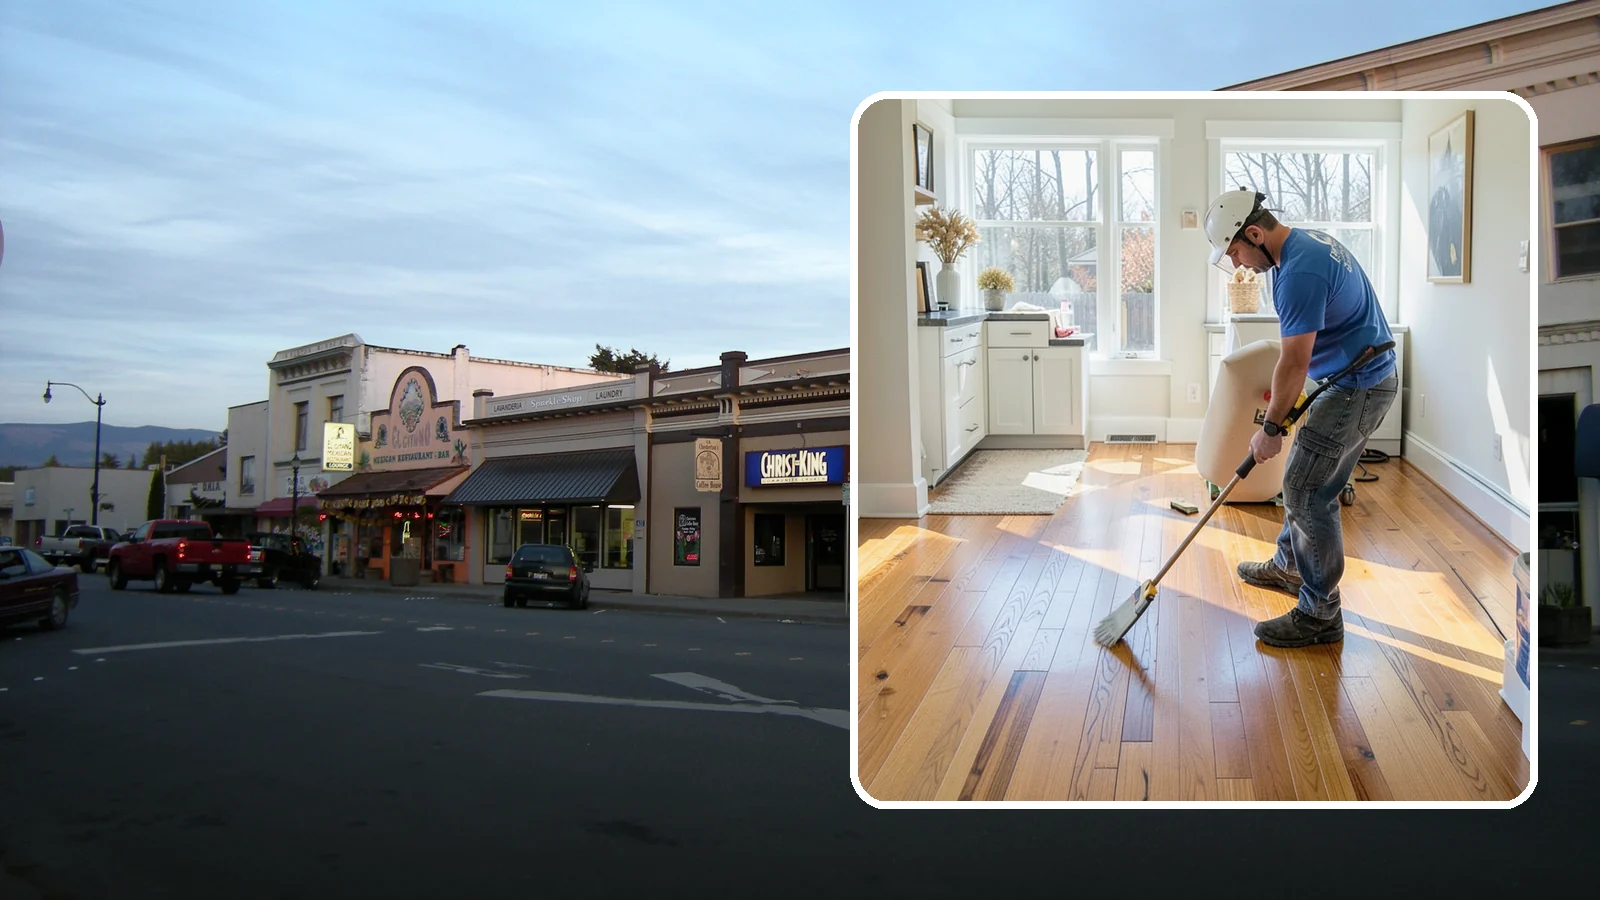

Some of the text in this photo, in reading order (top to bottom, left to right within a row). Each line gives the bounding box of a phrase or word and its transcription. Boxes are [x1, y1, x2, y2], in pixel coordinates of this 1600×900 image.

[493, 389, 624, 413] LAVANDERIA Sparkle Shop LAUNDRY
[397, 451, 433, 462] RESTAURANT
[438, 450, 450, 459] BAR
[761, 450, 827, 478] CHRIST KING
